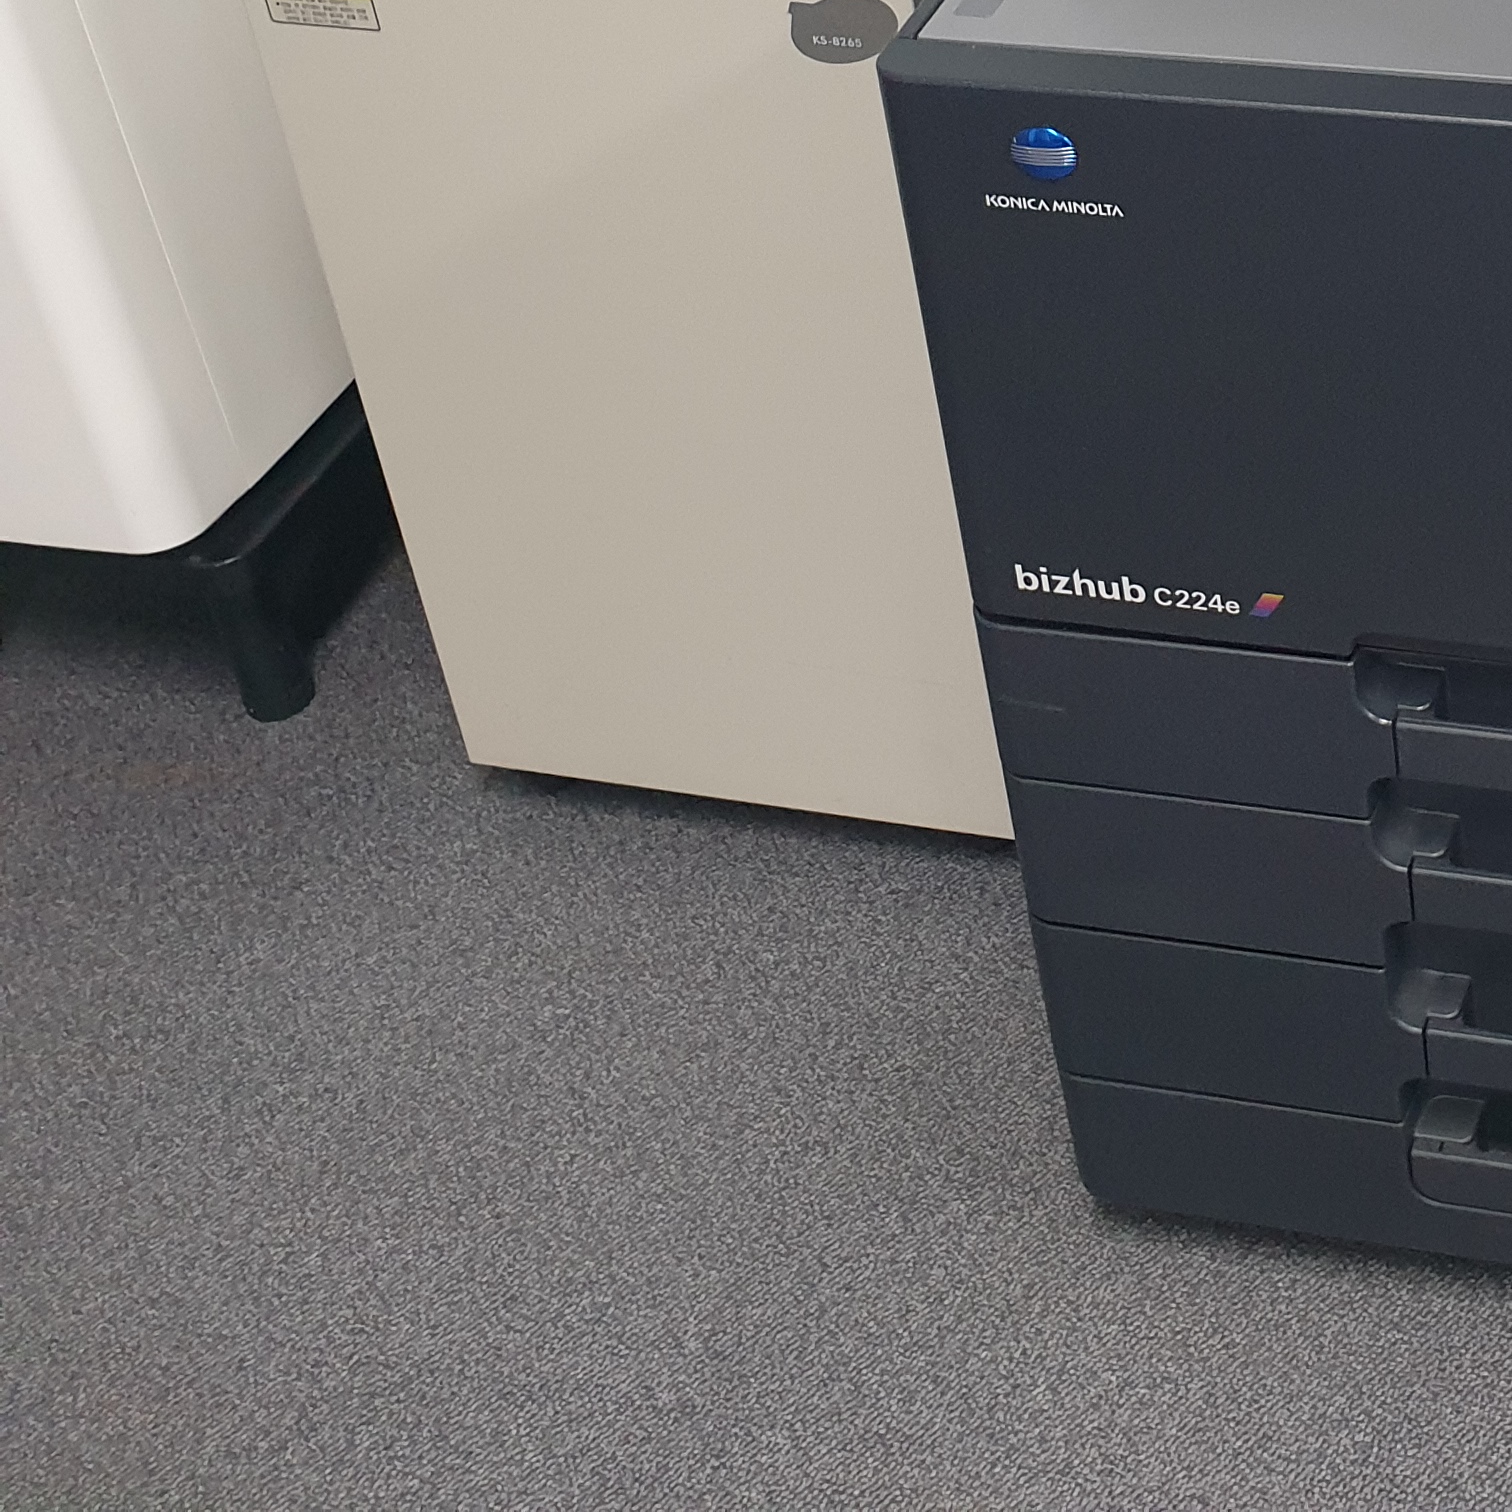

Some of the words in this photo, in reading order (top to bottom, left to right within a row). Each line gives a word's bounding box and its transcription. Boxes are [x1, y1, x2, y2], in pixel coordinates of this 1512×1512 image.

[985, 194, 1050, 212] KONICA
[1052, 200, 1124, 218] MINOLTA
[1014, 563, 1147, 603] bizhub
[1153, 587, 1241, 614] C224e
